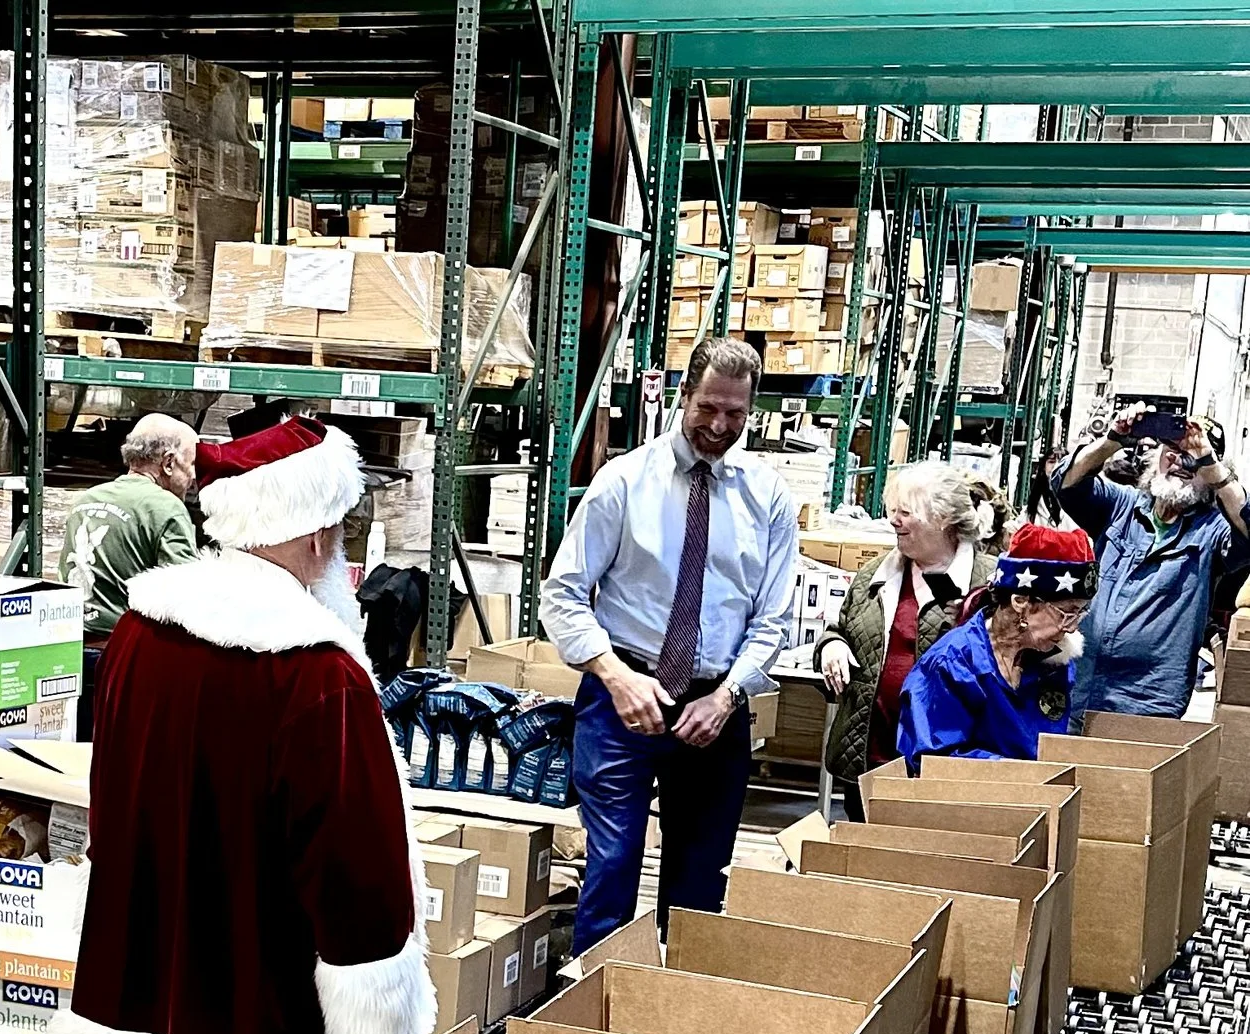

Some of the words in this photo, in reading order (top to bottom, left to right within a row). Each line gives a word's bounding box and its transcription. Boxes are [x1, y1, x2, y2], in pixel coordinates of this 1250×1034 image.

[2, 600, 31, 616] GOYA
[39, 603, 81, 627] plantain
[0, 709, 26, 726] GOYA
[40, 701, 64, 718] sweet
[5, 959, 61, 981] plantain
[5, 984, 57, 1006] GOYA
